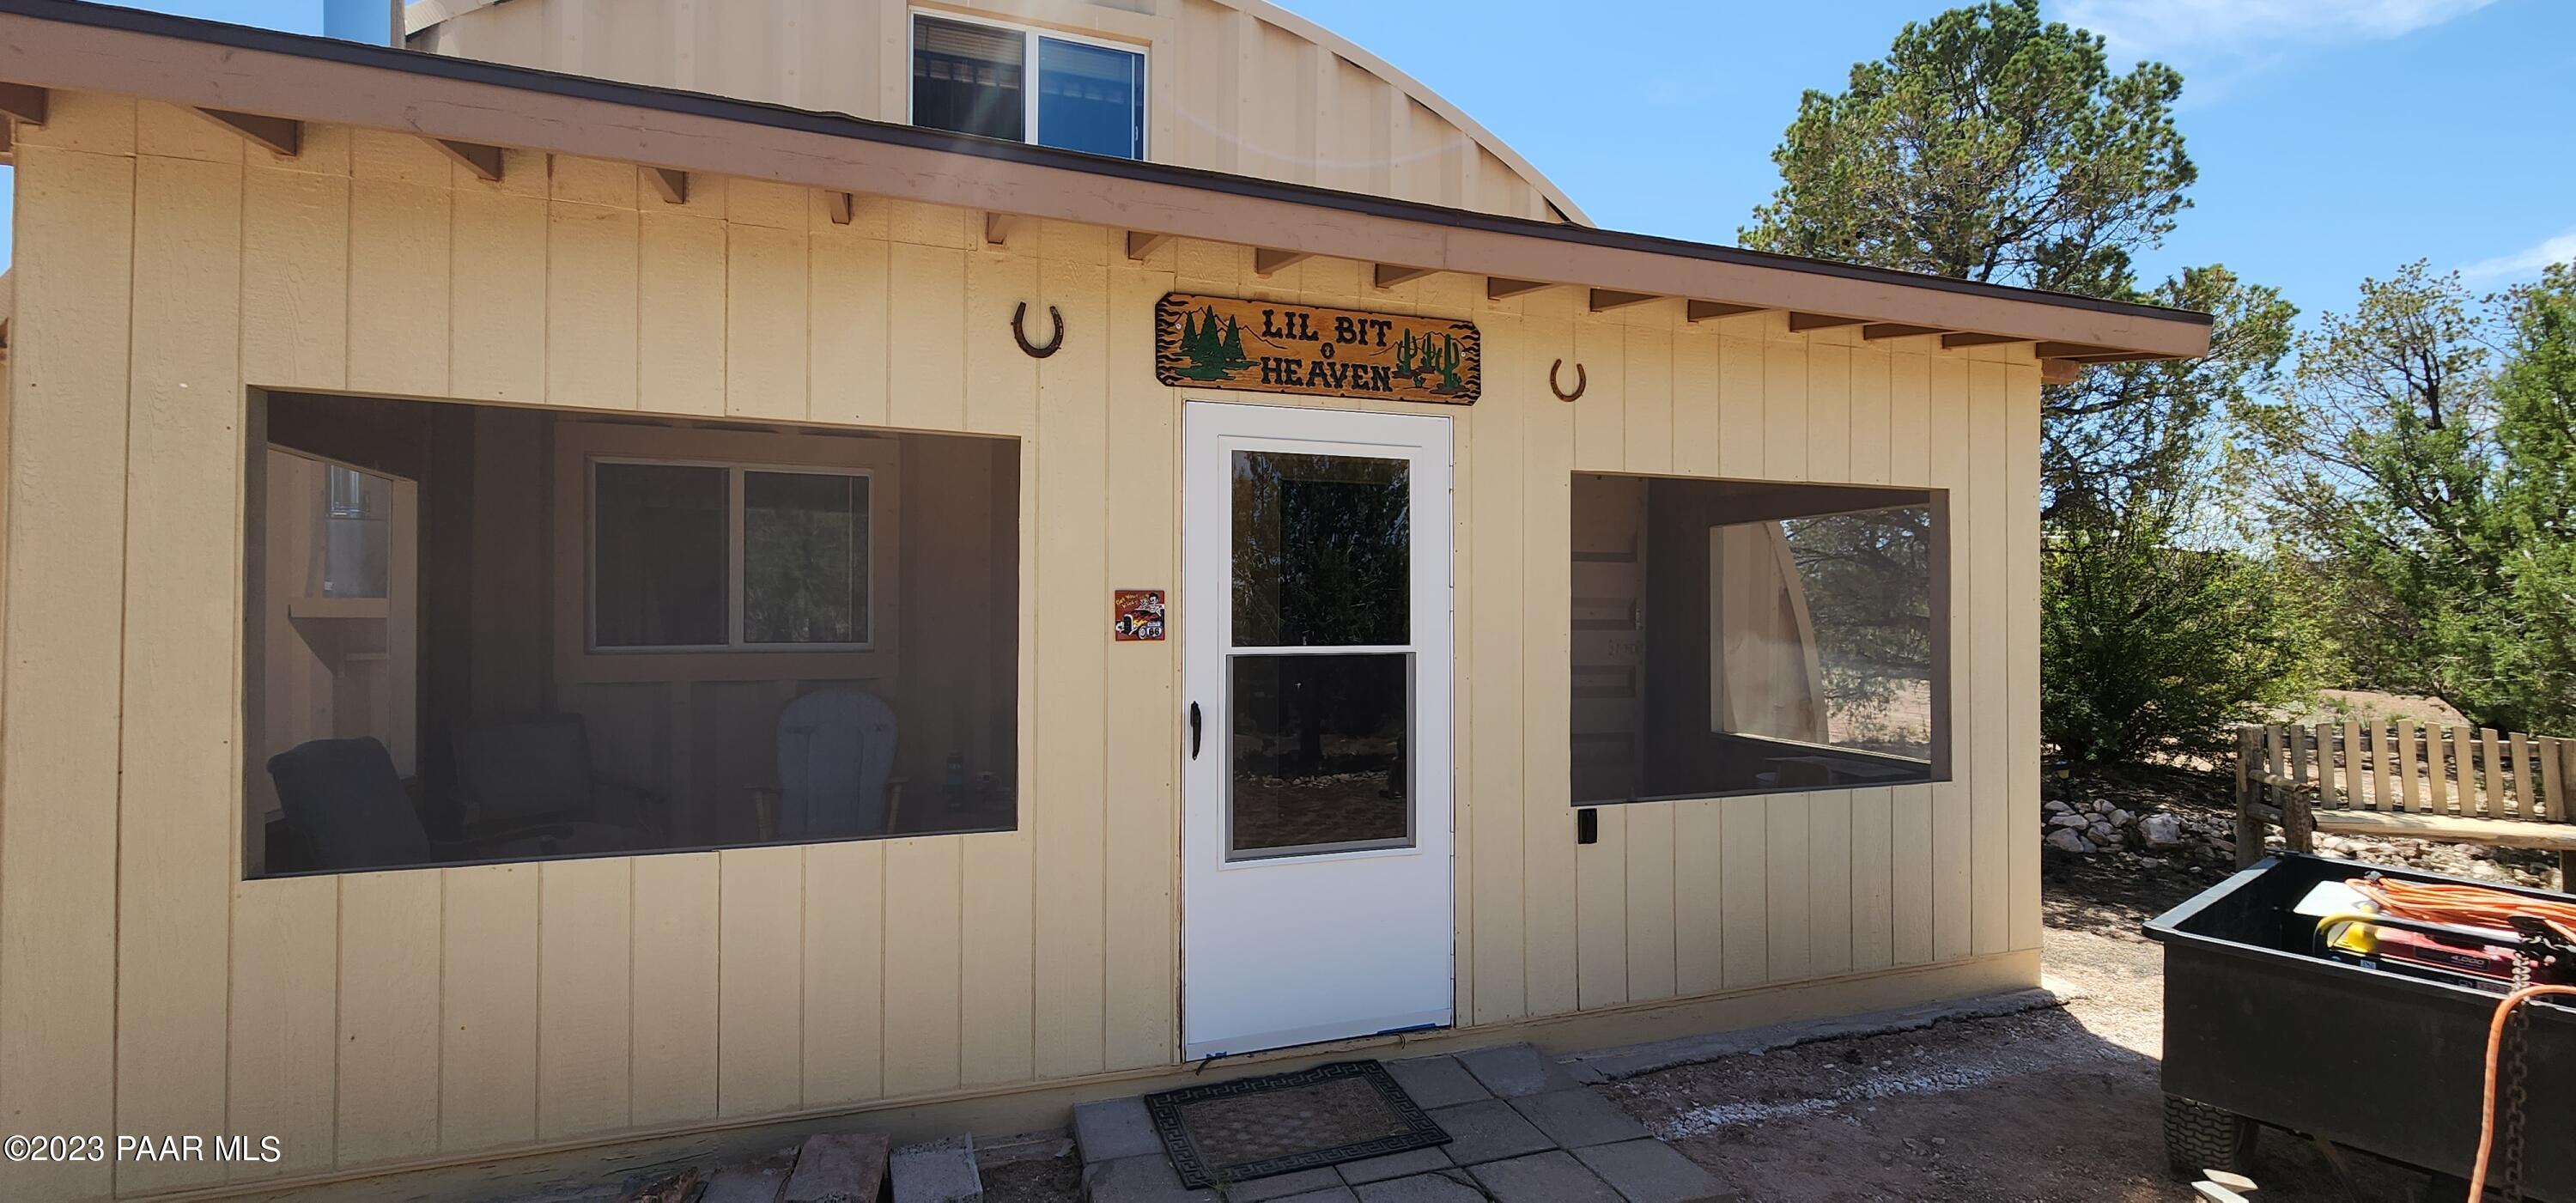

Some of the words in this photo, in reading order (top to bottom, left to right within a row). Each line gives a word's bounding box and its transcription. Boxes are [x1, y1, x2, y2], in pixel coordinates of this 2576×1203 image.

[1262, 309, 1319, 341] LIL
[1334, 316, 1392, 347] BIT
[1260, 356, 1393, 392] HEAVEN
